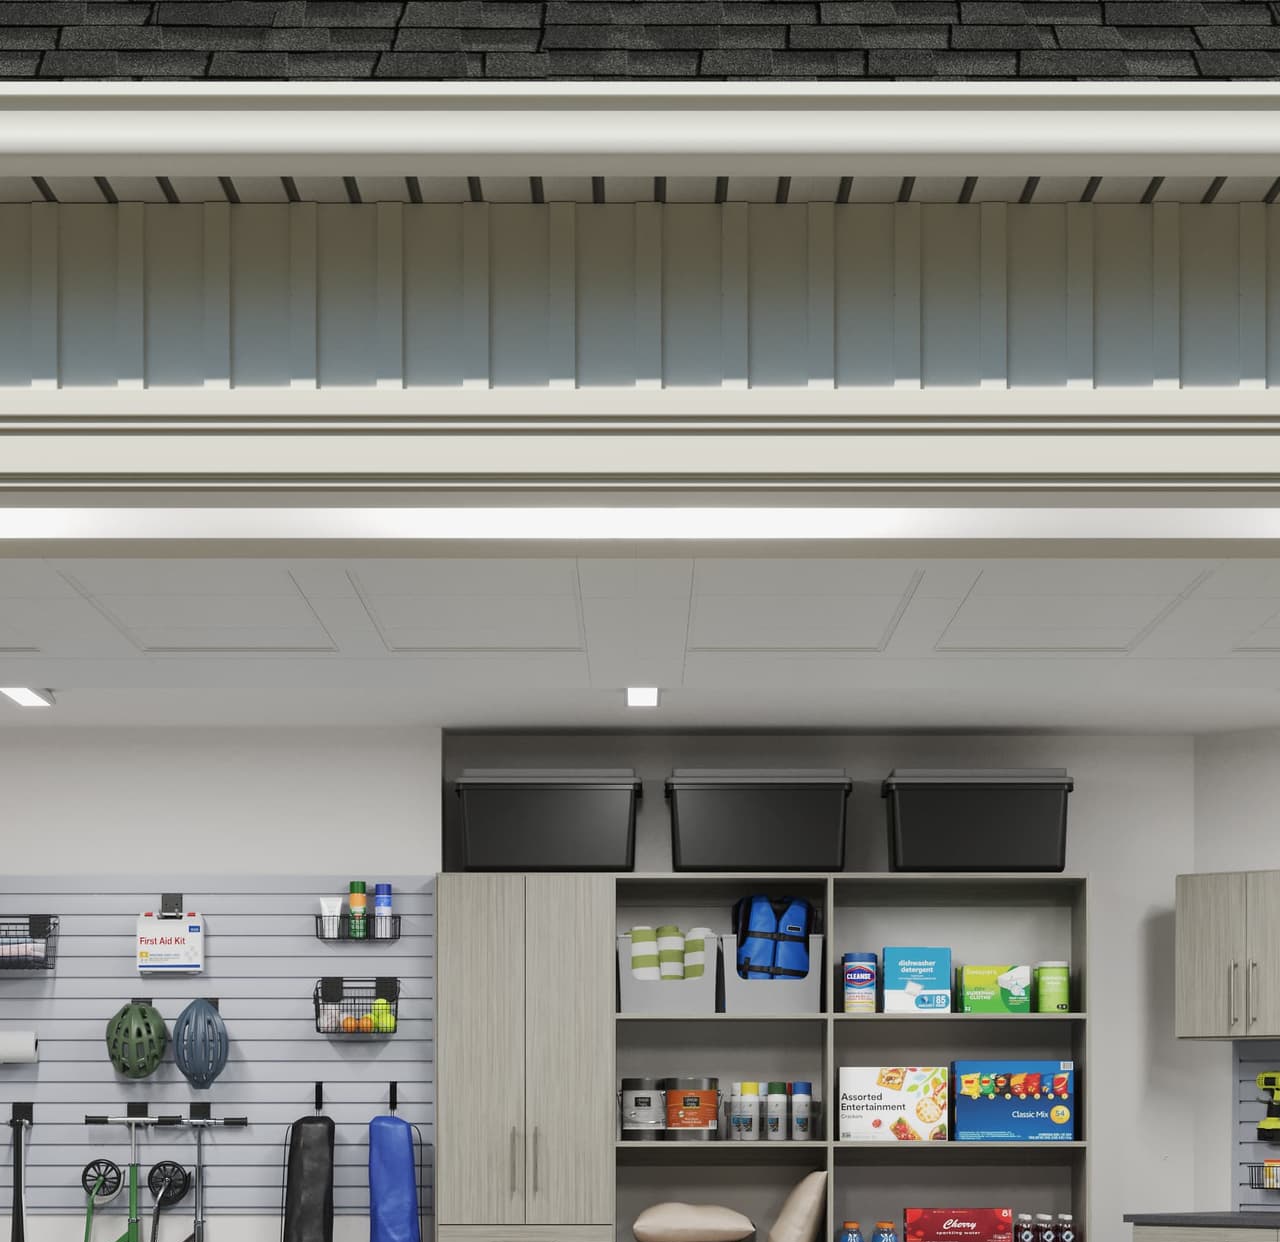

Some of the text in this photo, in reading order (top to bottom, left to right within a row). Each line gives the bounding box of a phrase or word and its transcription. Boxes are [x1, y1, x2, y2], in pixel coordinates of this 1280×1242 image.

[139, 937, 186, 945] First Aid Kit
[901, 967, 934, 975] detergent
[935, 996, 946, 1004] 85
[841, 1093, 882, 1101] Assorted
[841, 1103, 906, 1111] Entertainment
[1011, 1110, 1049, 1118] Classic Mix
[942, 1218, 977, 1230] Cherry
